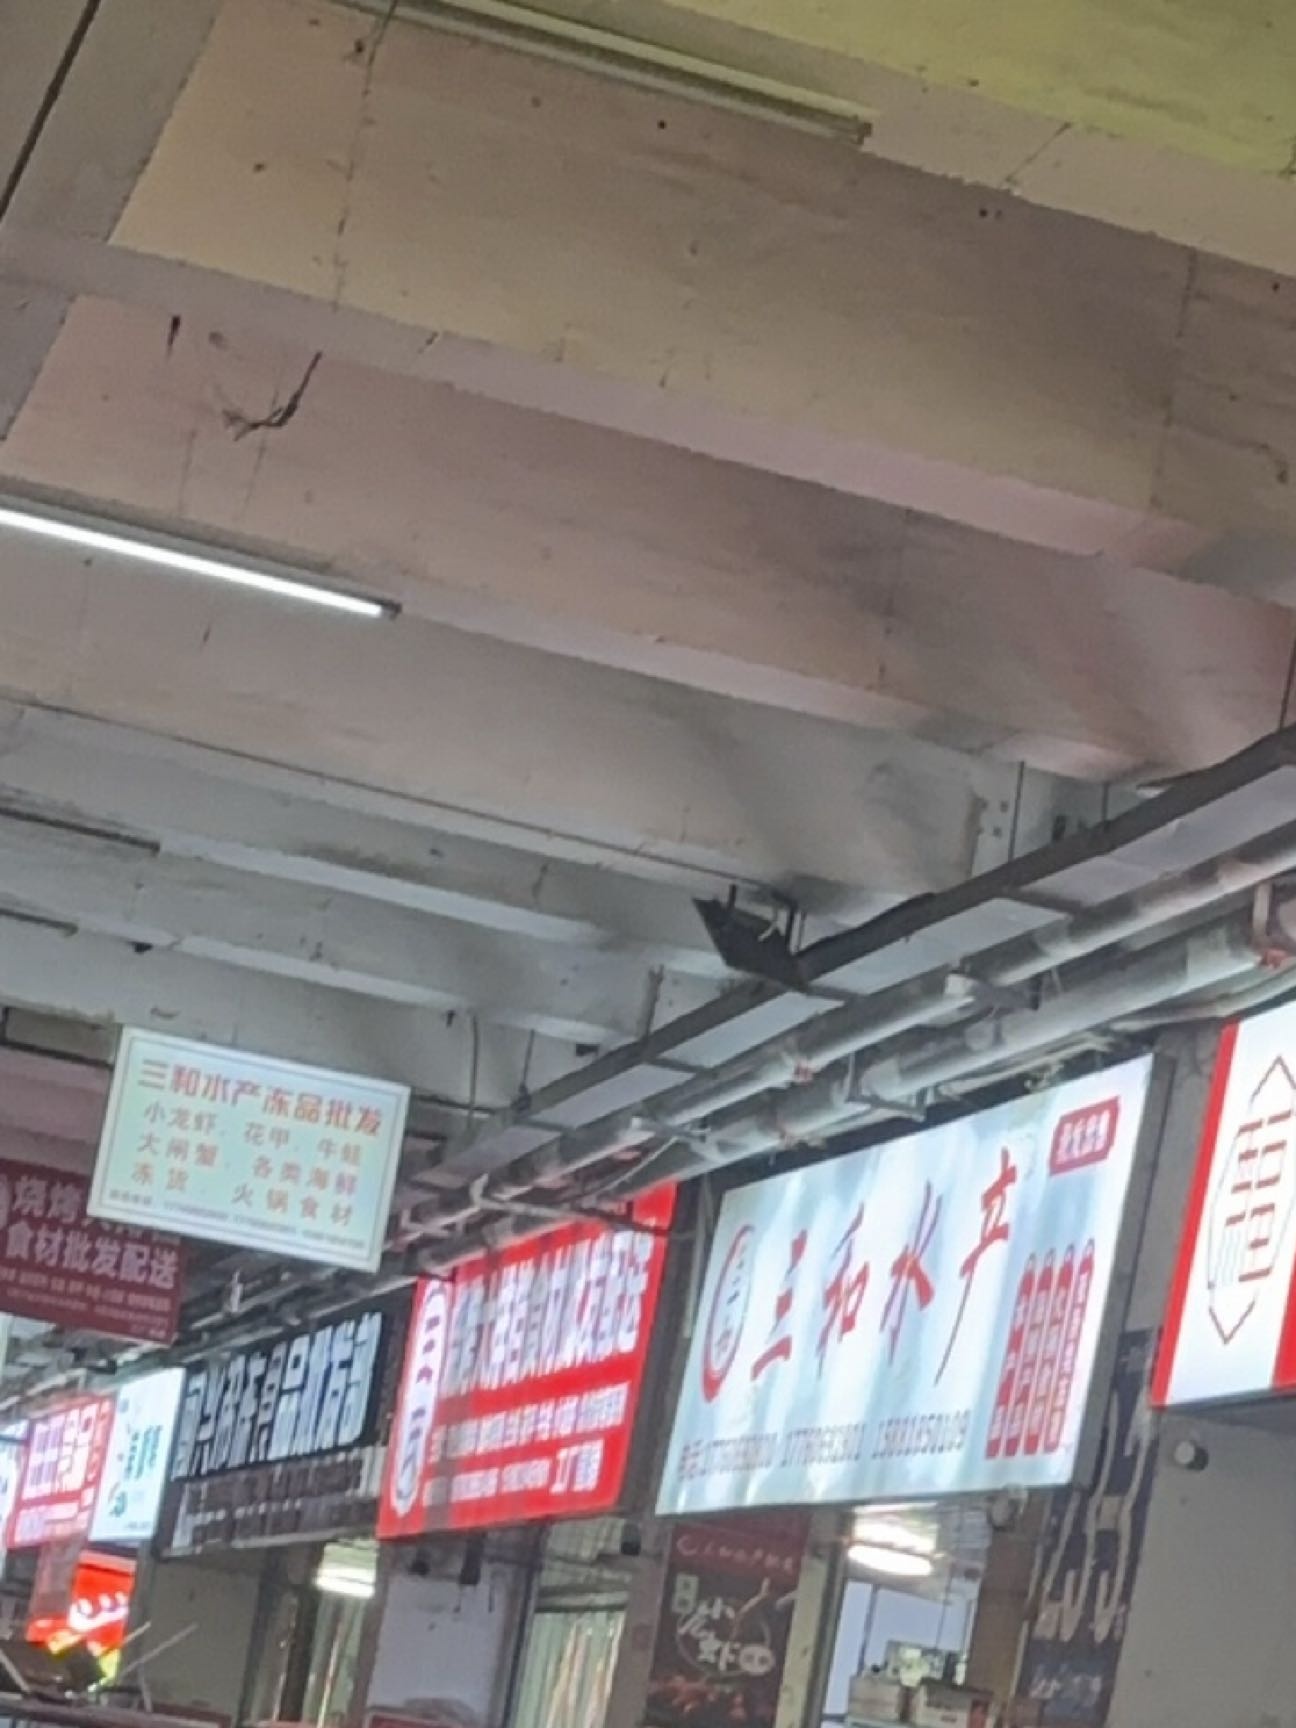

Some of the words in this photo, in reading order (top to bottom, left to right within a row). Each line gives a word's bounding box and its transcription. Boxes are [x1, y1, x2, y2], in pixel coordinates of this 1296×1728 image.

[138, 1059, 381, 1137] 三和水产冻品批发
[750, 1146, 1016, 1386] 三和水产
